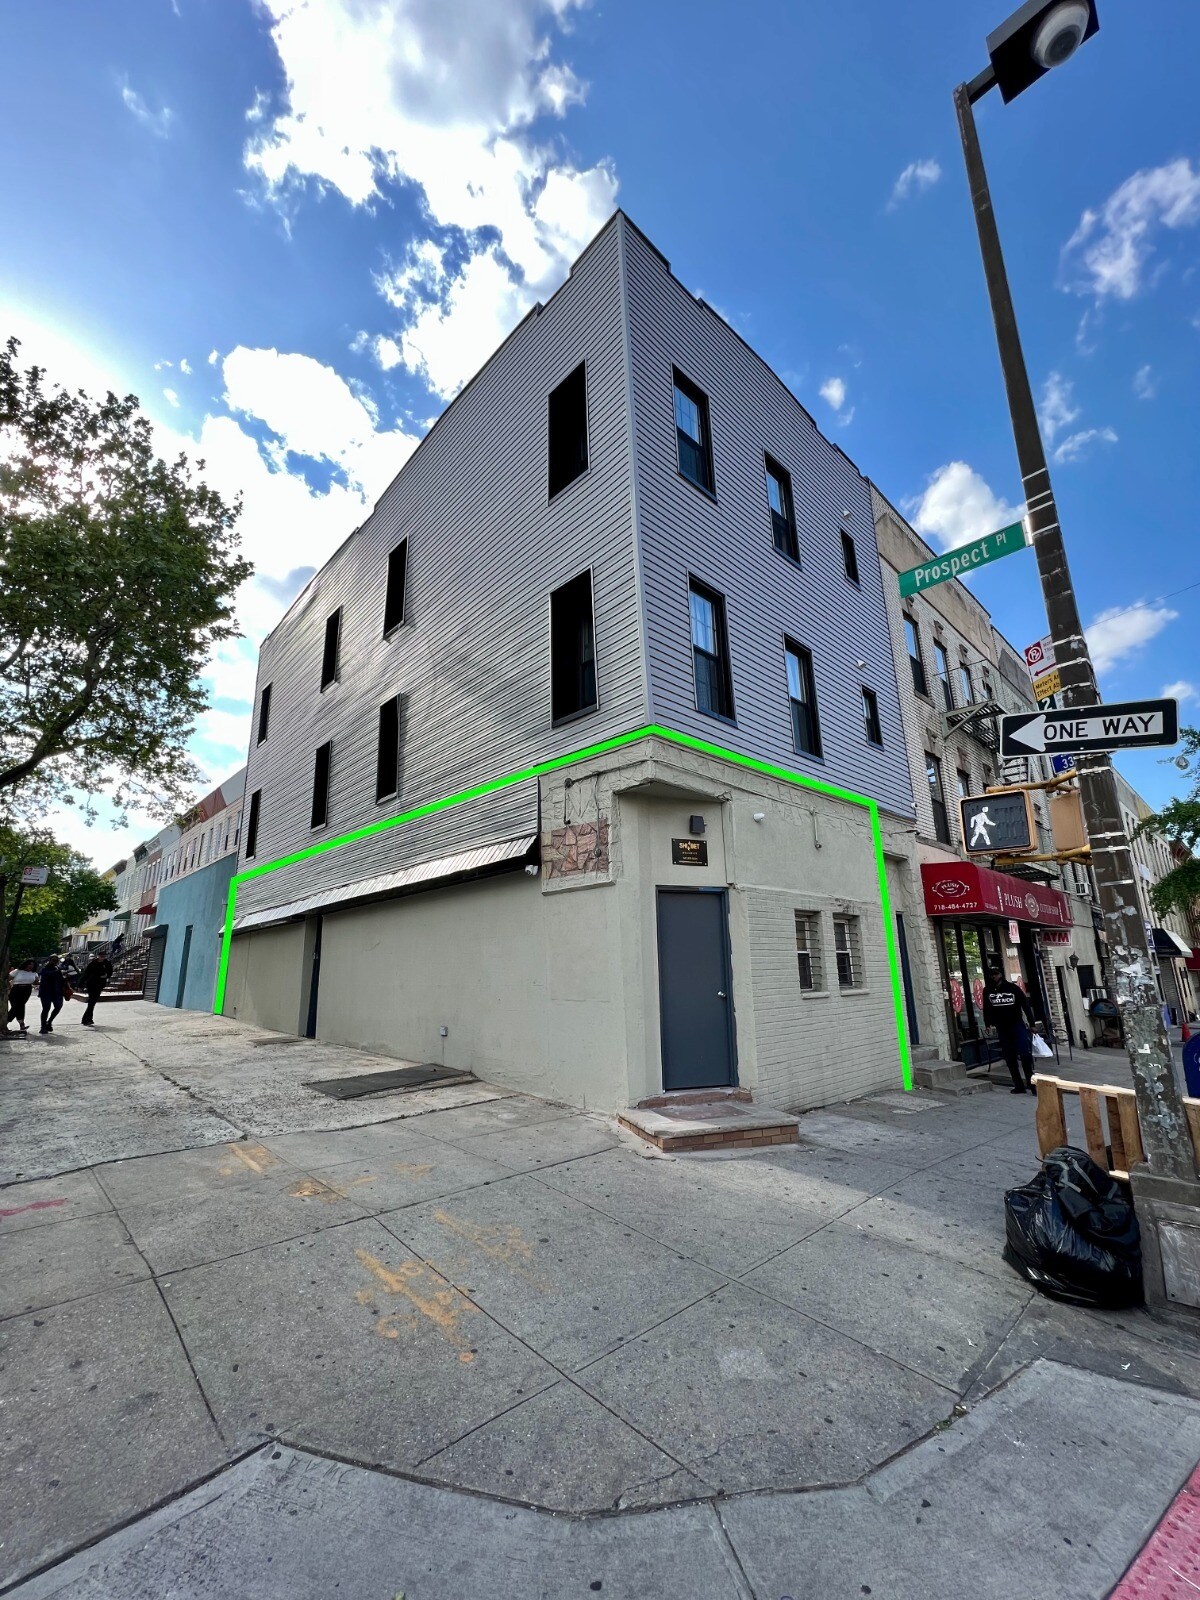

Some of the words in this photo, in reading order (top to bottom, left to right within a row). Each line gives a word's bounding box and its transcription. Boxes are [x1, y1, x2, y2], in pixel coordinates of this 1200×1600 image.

[914, 541, 990, 587] Prospect
[995, 532, 1007, 546] Pl
[1035, 677, 1053, 689] Meters
[1036, 685, 1052, 698] Effect
[1043, 721, 1088, 741] ONE
[1102, 714, 1155, 735] WAY
[1003, 893, 1023, 909] PLUSH
[1042, 931, 1069, 943] ATM
